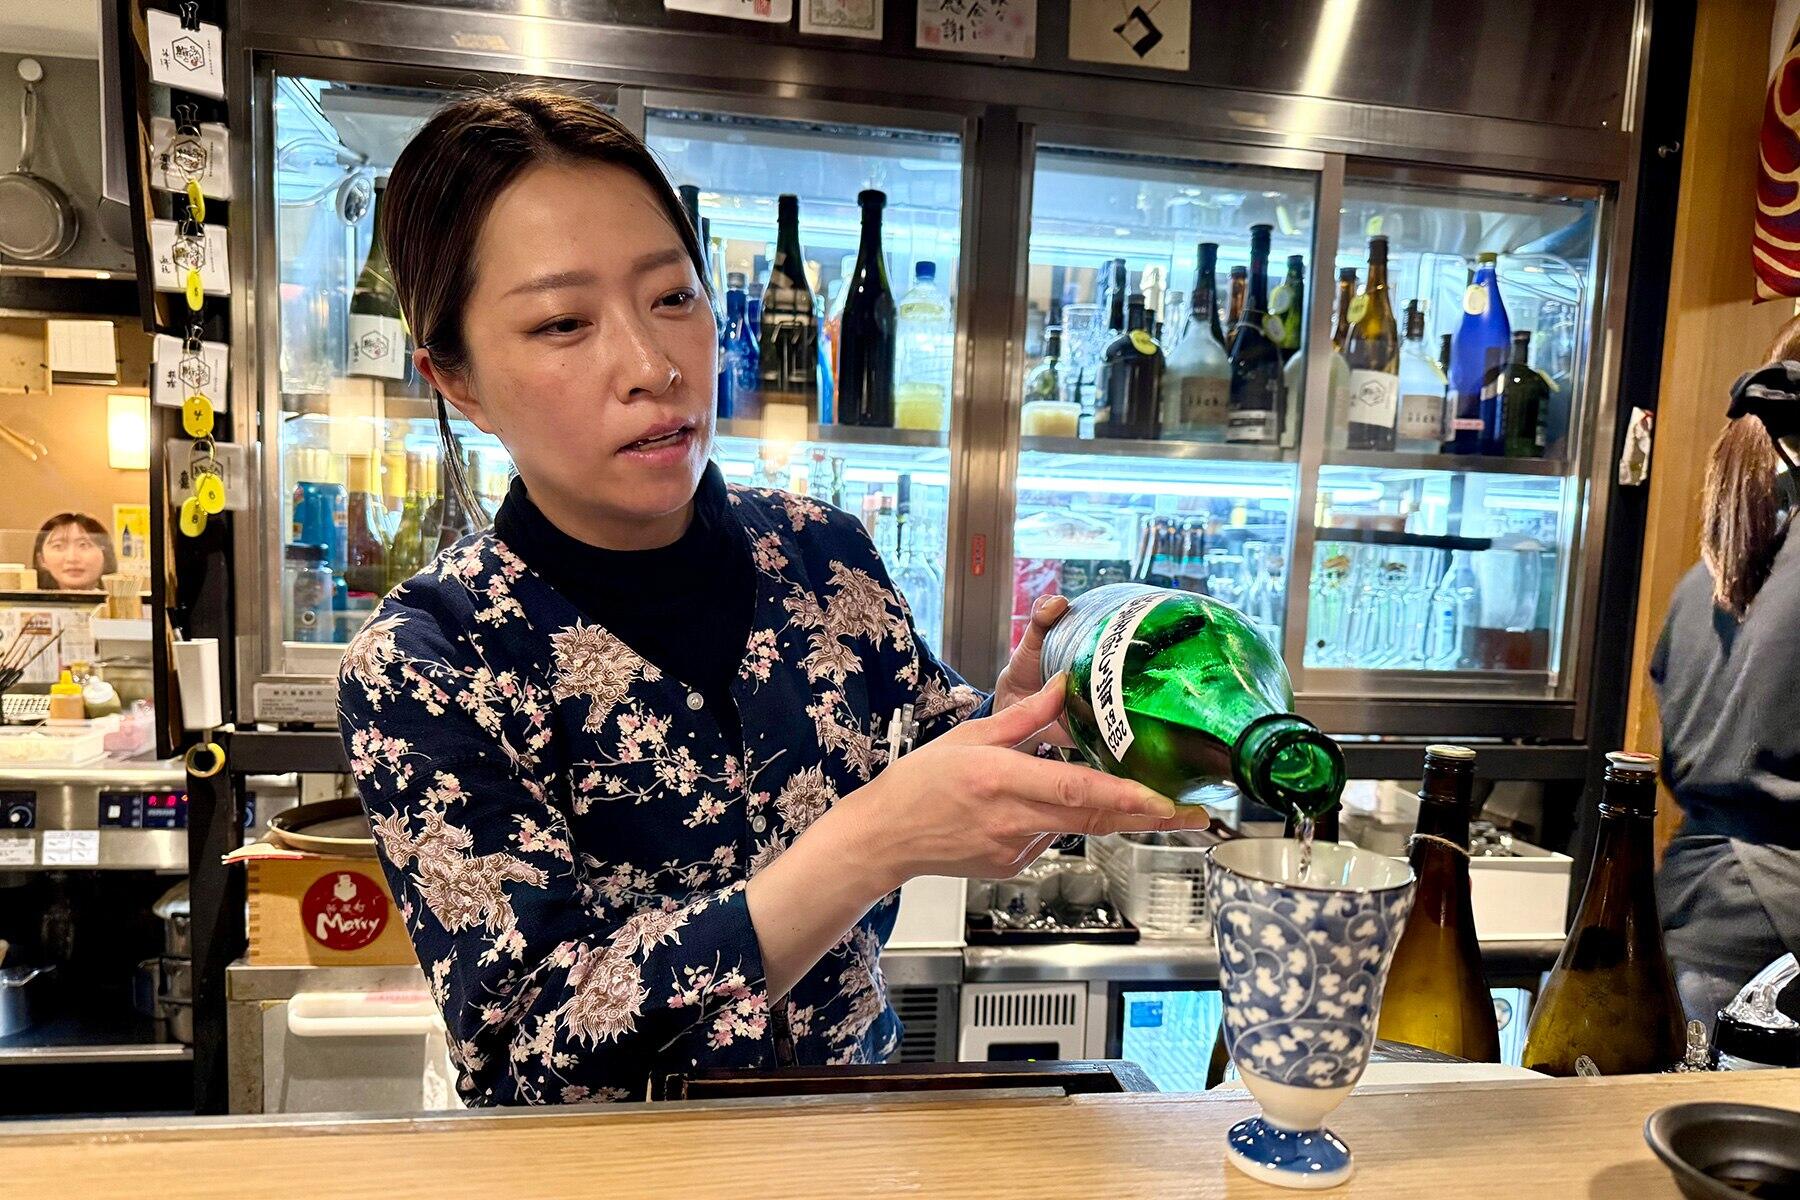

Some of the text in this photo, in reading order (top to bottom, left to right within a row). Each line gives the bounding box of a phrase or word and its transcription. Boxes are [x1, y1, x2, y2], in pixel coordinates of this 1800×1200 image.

[1104, 709, 1117, 733] BY
[1107, 719, 1128, 754] 2025
[316, 913, 381, 940] Merry
